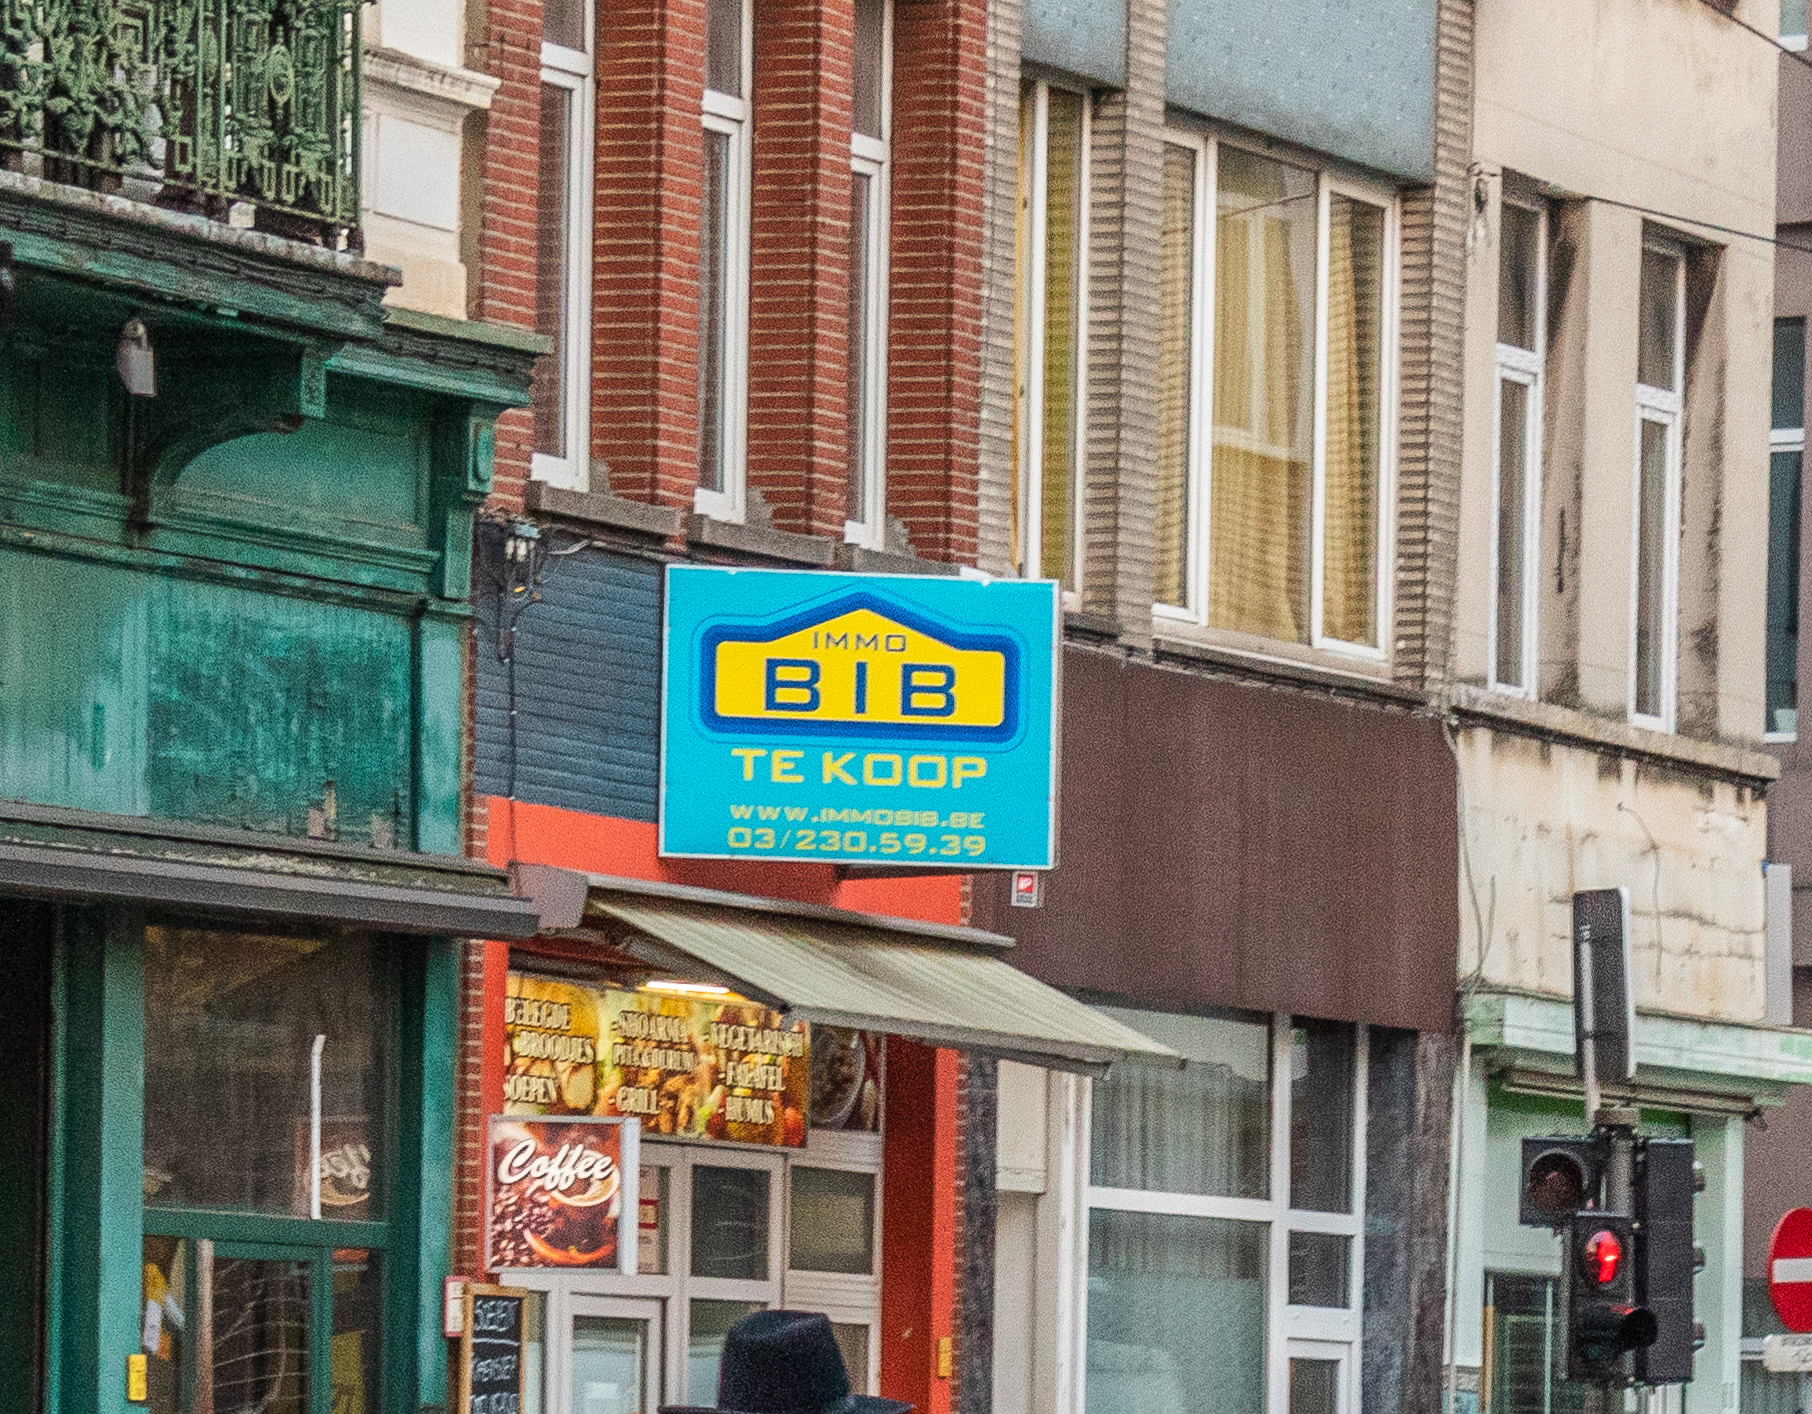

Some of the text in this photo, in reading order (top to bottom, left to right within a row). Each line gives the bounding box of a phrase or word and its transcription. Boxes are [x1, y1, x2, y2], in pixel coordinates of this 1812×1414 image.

[812, 630, 907, 653] IMMO
[763, 656, 957, 718] BIB
[731, 747, 988, 789] TE KOOP
[727, 826, 987, 857] 03/230.59.39
[497, 1138, 615, 1190] Coffee
